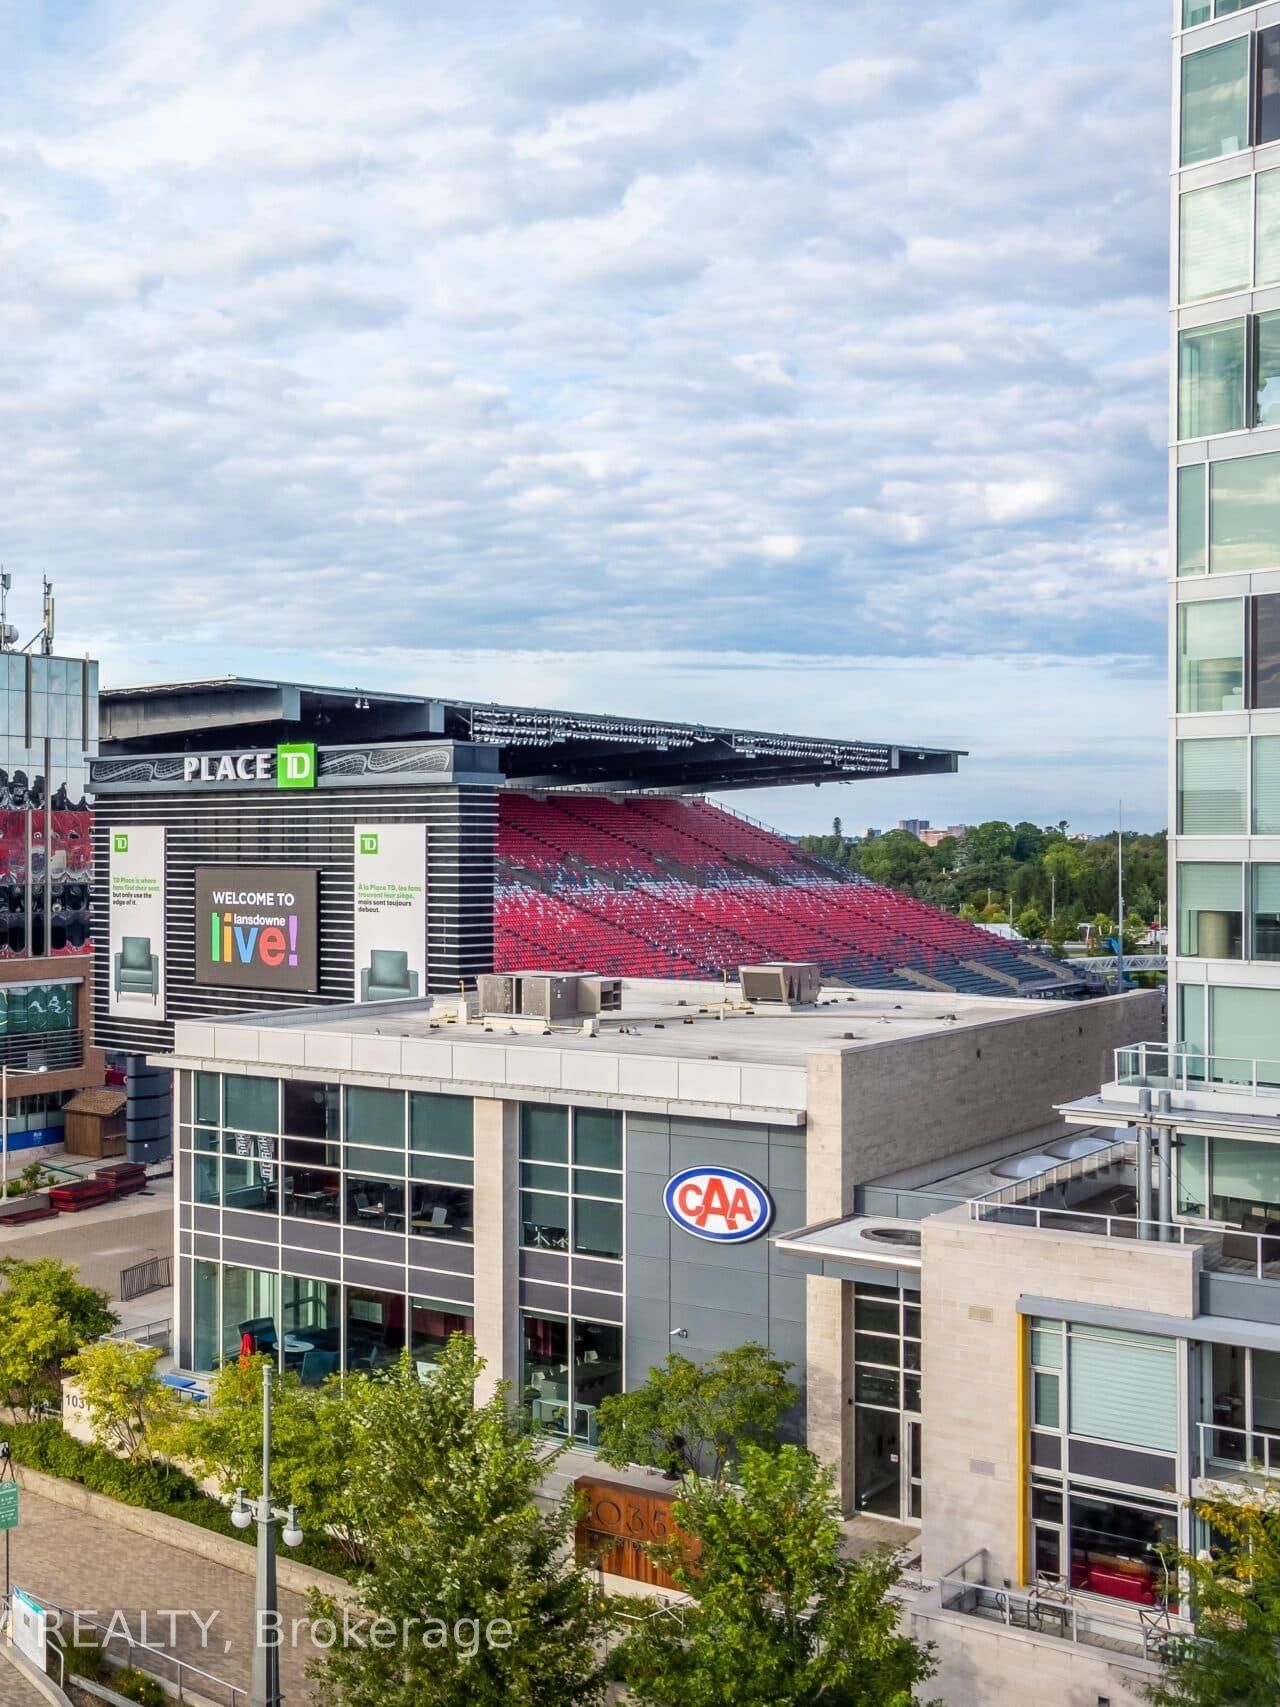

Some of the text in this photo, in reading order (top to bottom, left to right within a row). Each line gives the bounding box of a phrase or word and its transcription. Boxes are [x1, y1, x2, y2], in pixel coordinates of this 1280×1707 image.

[183, 752, 311, 782] PLACE TD
[361, 837, 377, 851] TD
[122, 892, 133, 900] only
[212, 890, 295, 906] WELCOME TO
[386, 900, 412, 908] toujours
[233, 913, 286, 926] lansdowne
[211, 912, 298, 967] live!
[678, 1177, 754, 1231] CAA
[585, 1495, 667, 1539] 035
